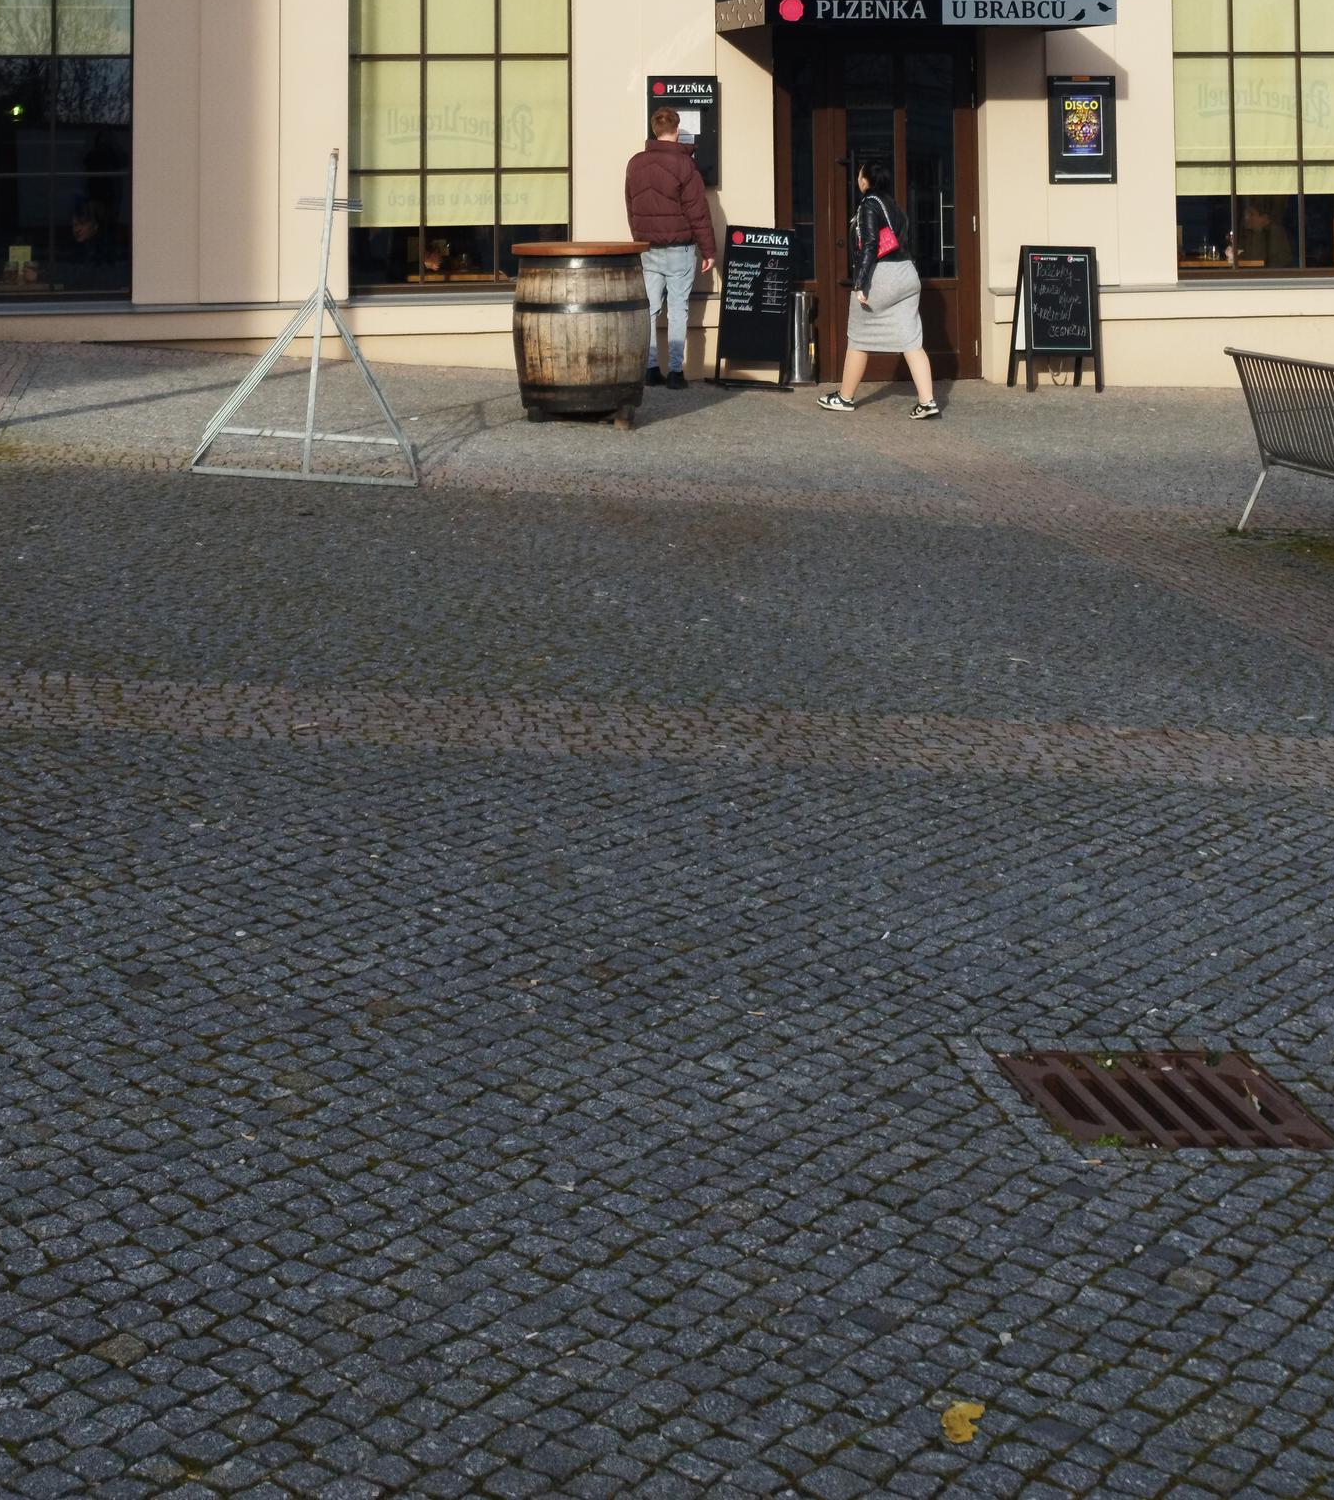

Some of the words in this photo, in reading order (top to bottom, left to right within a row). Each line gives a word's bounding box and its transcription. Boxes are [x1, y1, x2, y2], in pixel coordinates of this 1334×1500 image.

[952, 0, 966, 19] U
[667, 82, 713, 93] PLZEŇKA
[1064, 100, 1099, 110] DISCO
[745, 233, 789, 246] PLZEŇKA
